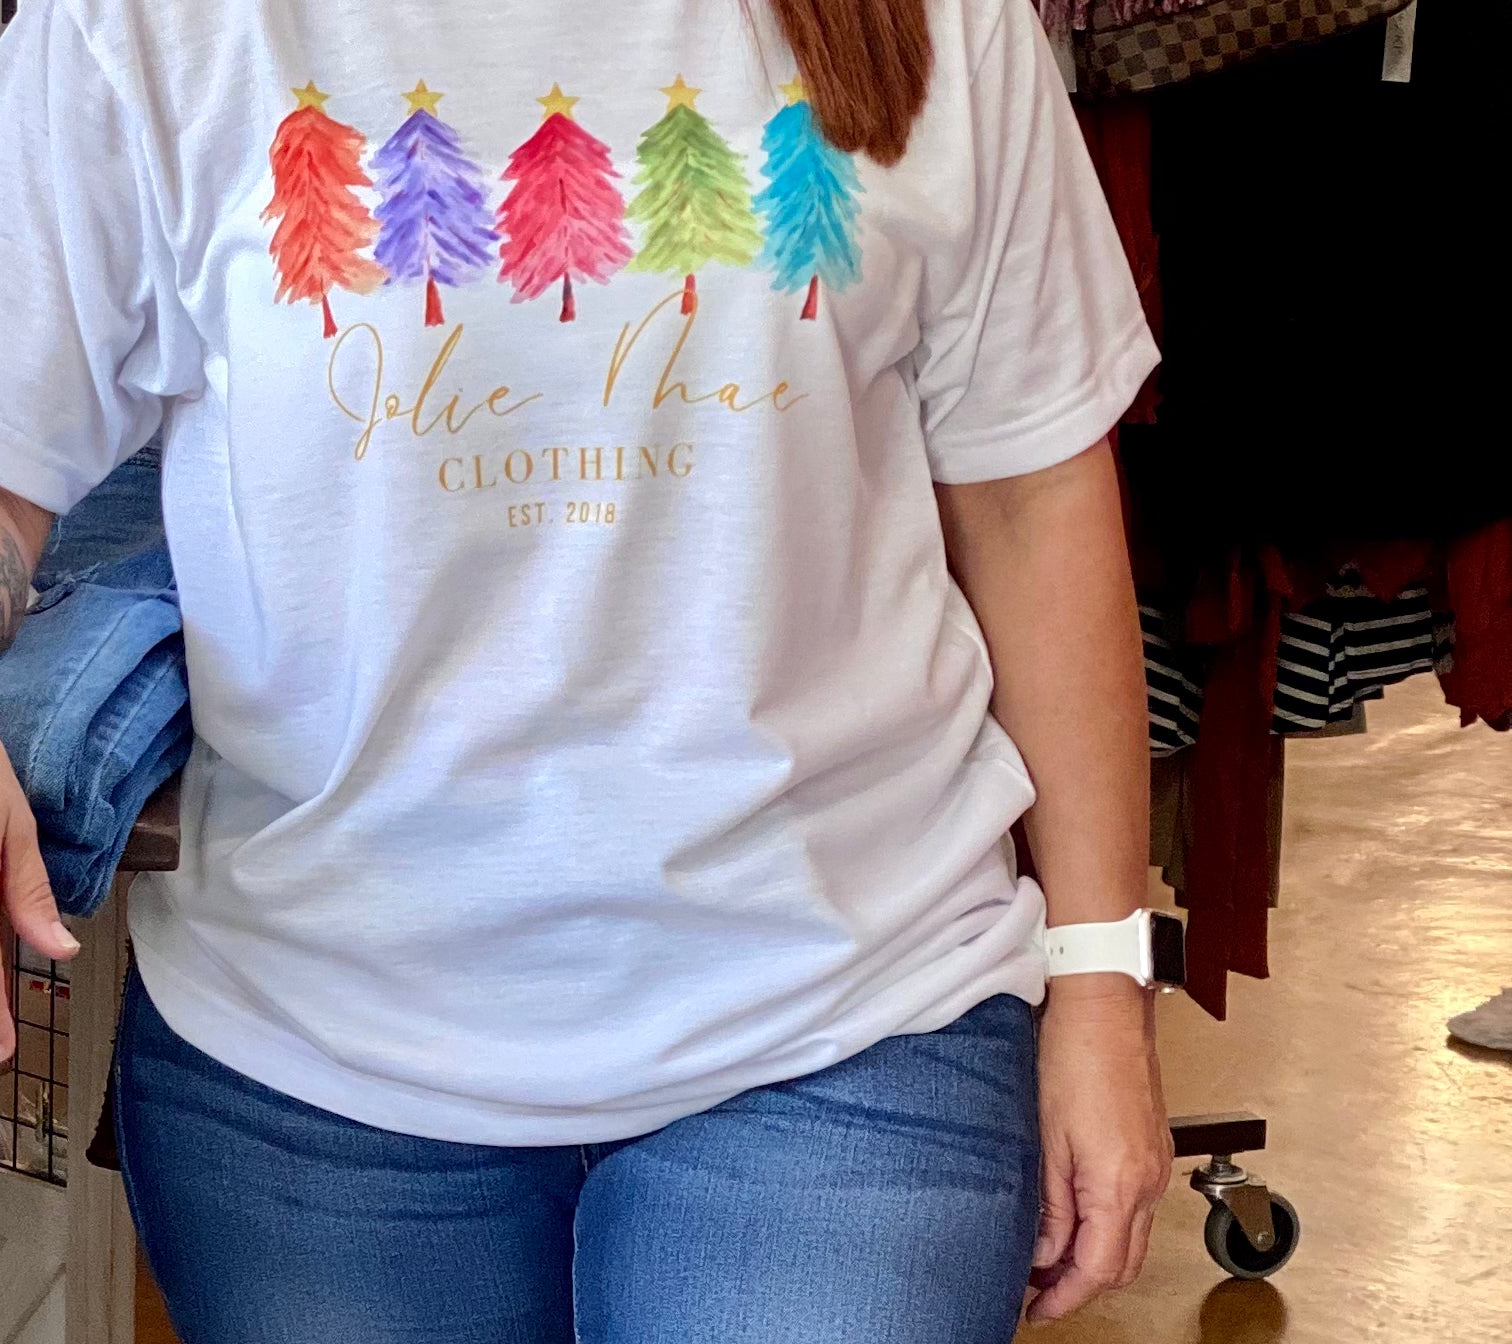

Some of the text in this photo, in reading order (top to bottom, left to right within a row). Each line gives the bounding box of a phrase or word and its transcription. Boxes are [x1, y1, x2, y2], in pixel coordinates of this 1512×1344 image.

[328, 289, 811, 461] Jolie Mae
[438, 441, 697, 492] CLOTHING
[508, 501, 616, 528] EST. 2018
